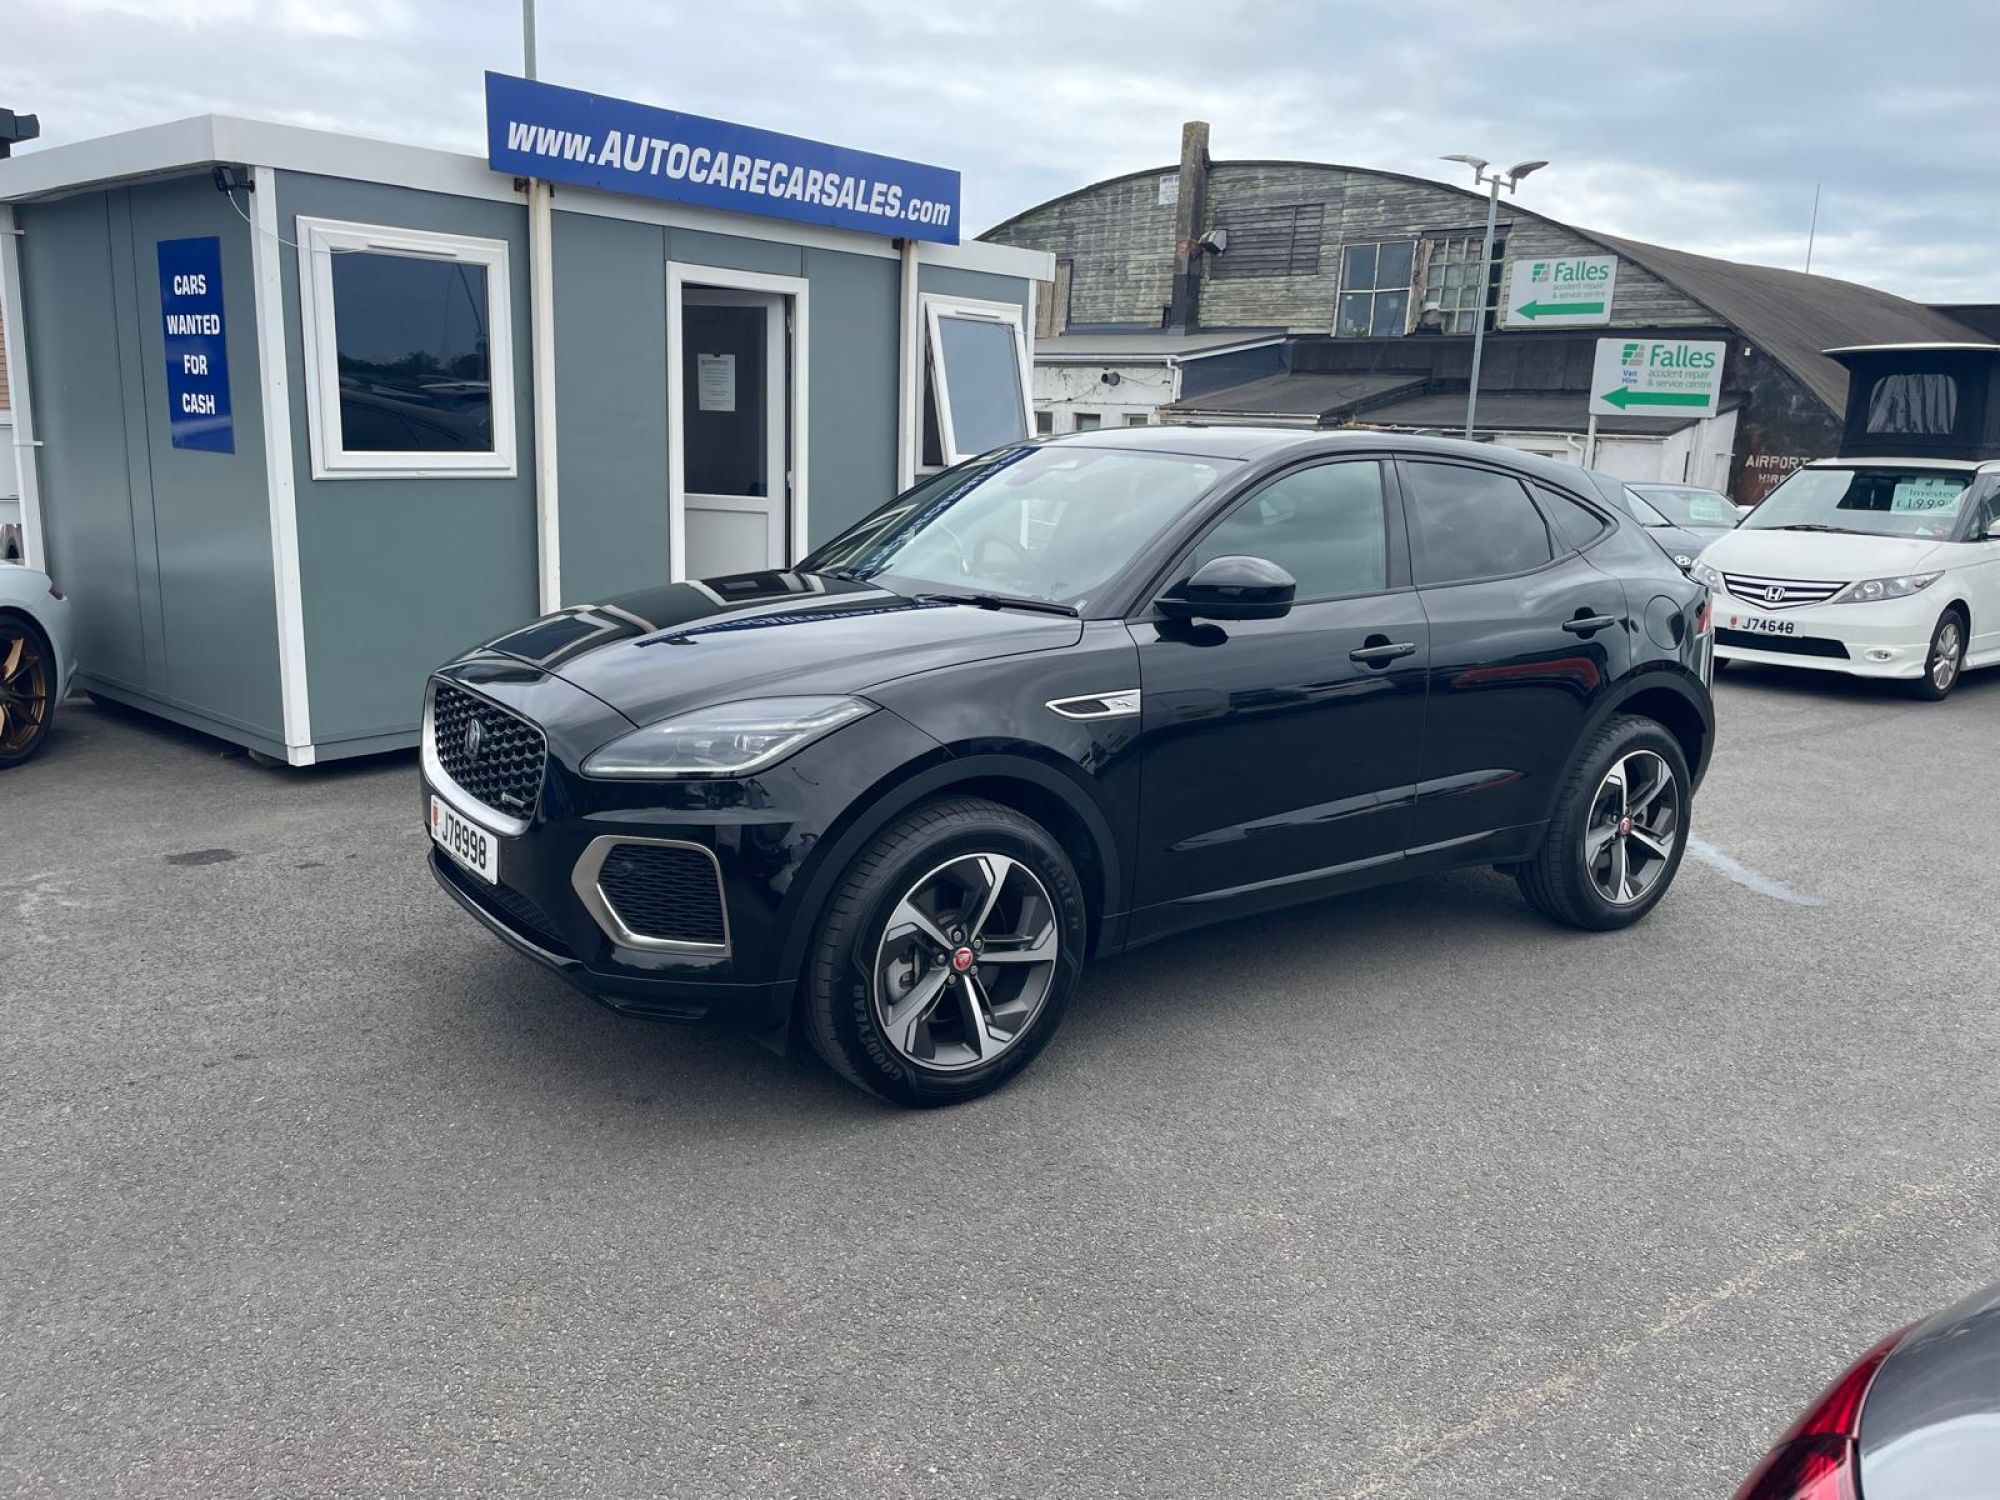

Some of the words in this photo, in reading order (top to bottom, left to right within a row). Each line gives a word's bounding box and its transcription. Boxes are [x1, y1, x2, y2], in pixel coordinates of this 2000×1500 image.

[1553, 260, 1610, 281] Falles
[173, 274, 207, 296] CARS
[1552, 283, 1581, 291] accident
[1583, 282, 1604, 292] repair
[166, 314, 221, 335] WANTED
[183, 354, 209, 376] FOR
[1650, 344, 1716, 369] Falles
[1623, 369, 1637, 377] Van
[1648, 369, 1682, 378] accident
[1685, 371, 1710, 380] repair
[1656, 379, 1683, 388] service
[1685, 380, 1712, 389] centre
[181, 393, 216, 415] CASH
[1744, 454, 1811, 470] AIRPORT
[1742, 617, 1794, 635] J74648
[442, 810, 487, 870] J78998
